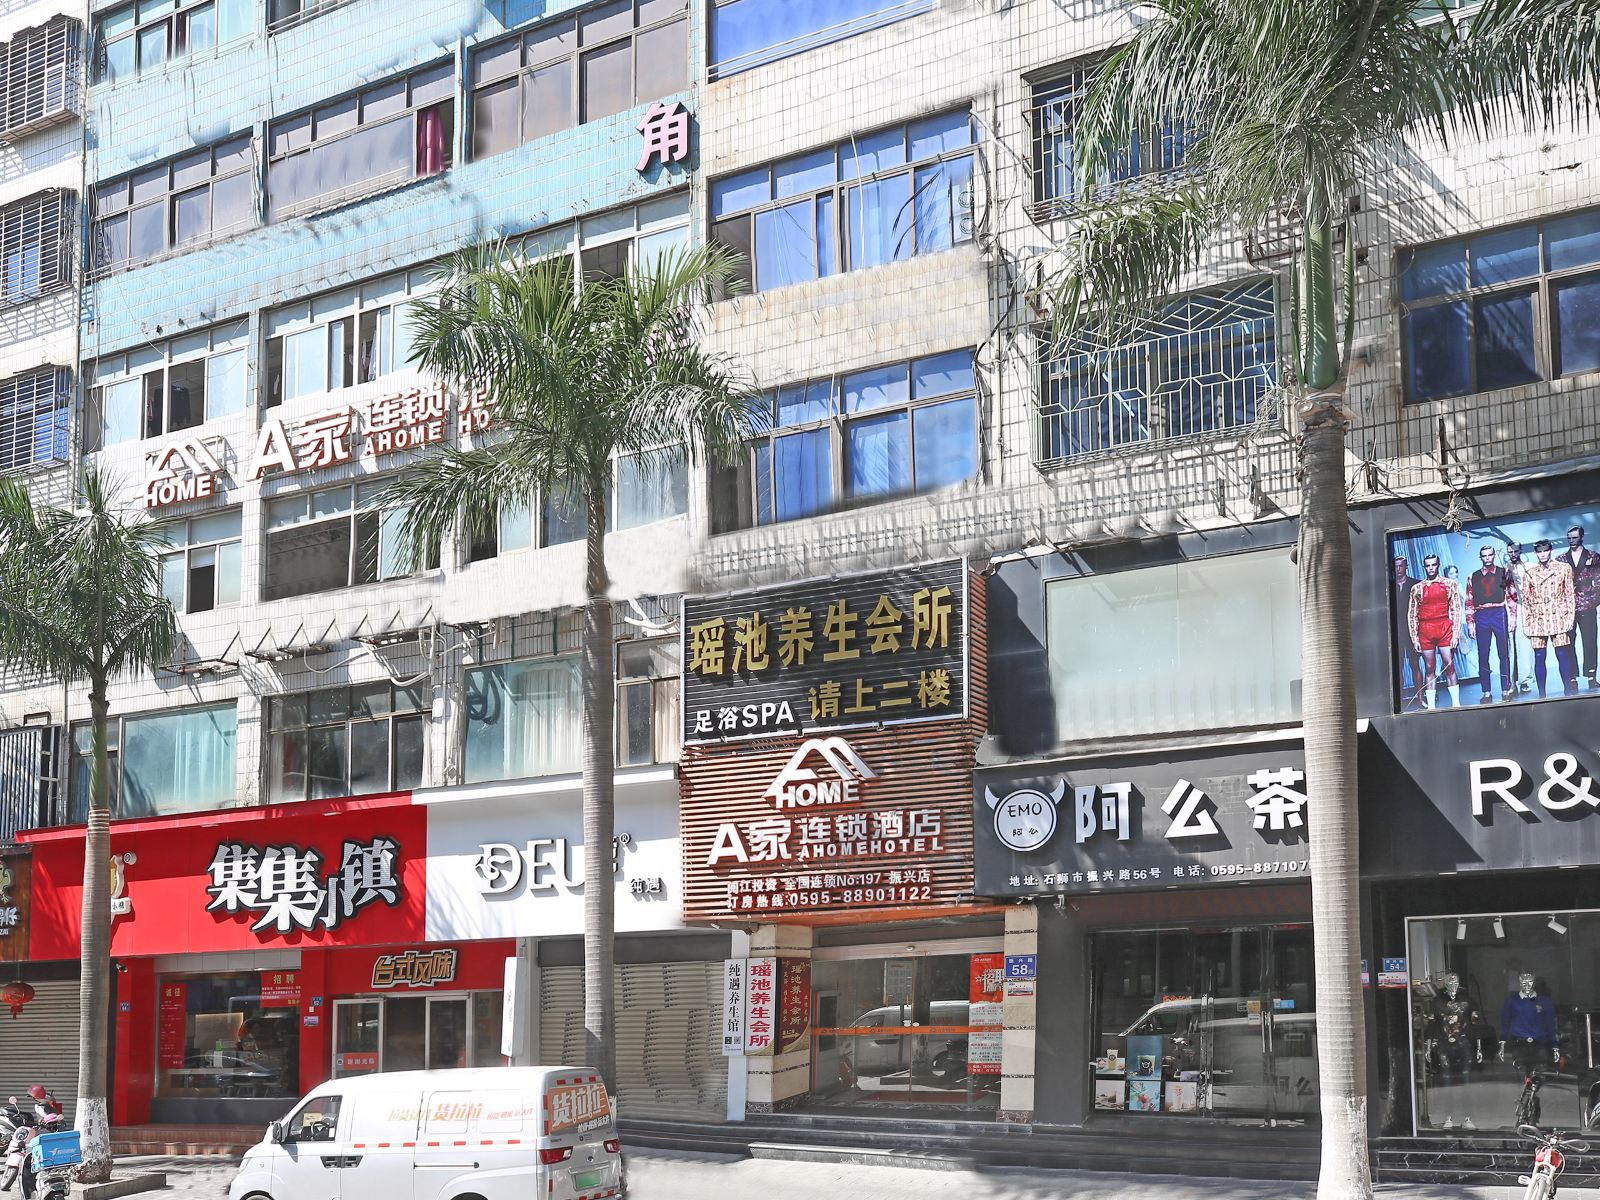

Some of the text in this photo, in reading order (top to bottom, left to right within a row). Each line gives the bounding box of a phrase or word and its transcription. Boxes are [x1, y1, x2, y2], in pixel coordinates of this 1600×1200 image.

[635, 102, 690, 173] 角
[144, 474, 214, 509] HOME
[689, 585, 952, 676] 瑶池养生会所
[693, 668, 951, 734] 足浴SPA 请上二楼
[775, 779, 860, 809] HOME
[1007, 803, 1043, 818] EMO
[1075, 766, 1308, 845] 阿么茶
[1468, 752, 1600, 817] R&
[206, 838, 398, 932] 集集小镇
[888, 868, 931, 885] 振兴店
[374, 950, 453, 985] 台式风味
[749, 965, 772, 1047] 瑶池养生会所
[432, 1103, 484, 1121] 货拉拉
[551, 1083, 608, 1128] 货拉拉
